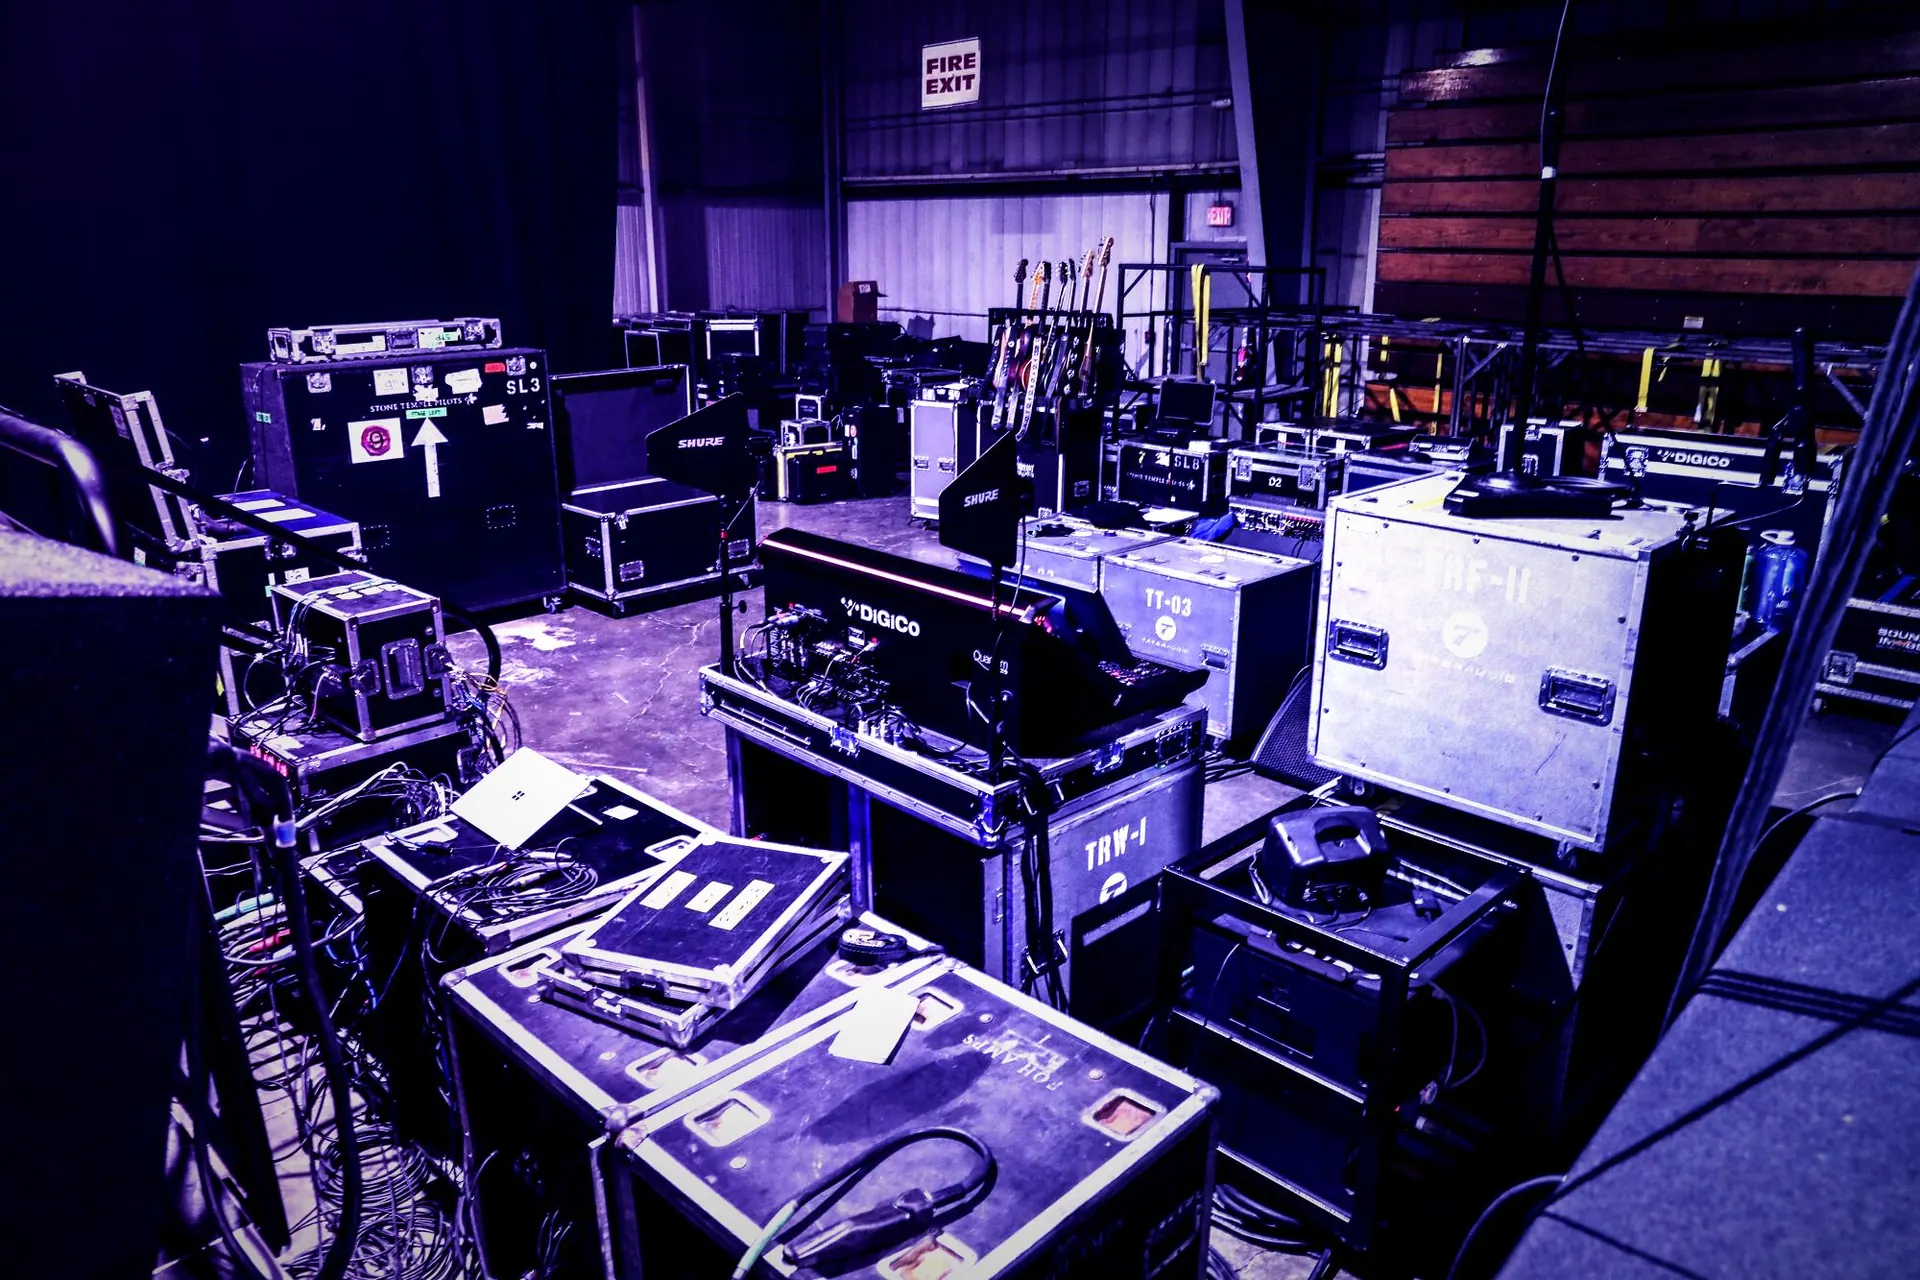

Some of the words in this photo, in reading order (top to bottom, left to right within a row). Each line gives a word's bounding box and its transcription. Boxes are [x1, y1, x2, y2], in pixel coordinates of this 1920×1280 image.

[926, 52, 976, 75] FIRE
[926, 73, 976, 95] EXIT
[506, 377, 541, 395] SL3
[370, 403, 399, 413] STONE
[435, 397, 463, 407] PILOTS
[677, 436, 726, 449] SHURE
[1174, 455, 1200, 470] SL8
[963, 488, 1000, 508] SHURE
[1144, 587, 1192, 617] TT-03
[1878, 628, 1920, 643] SOUN
